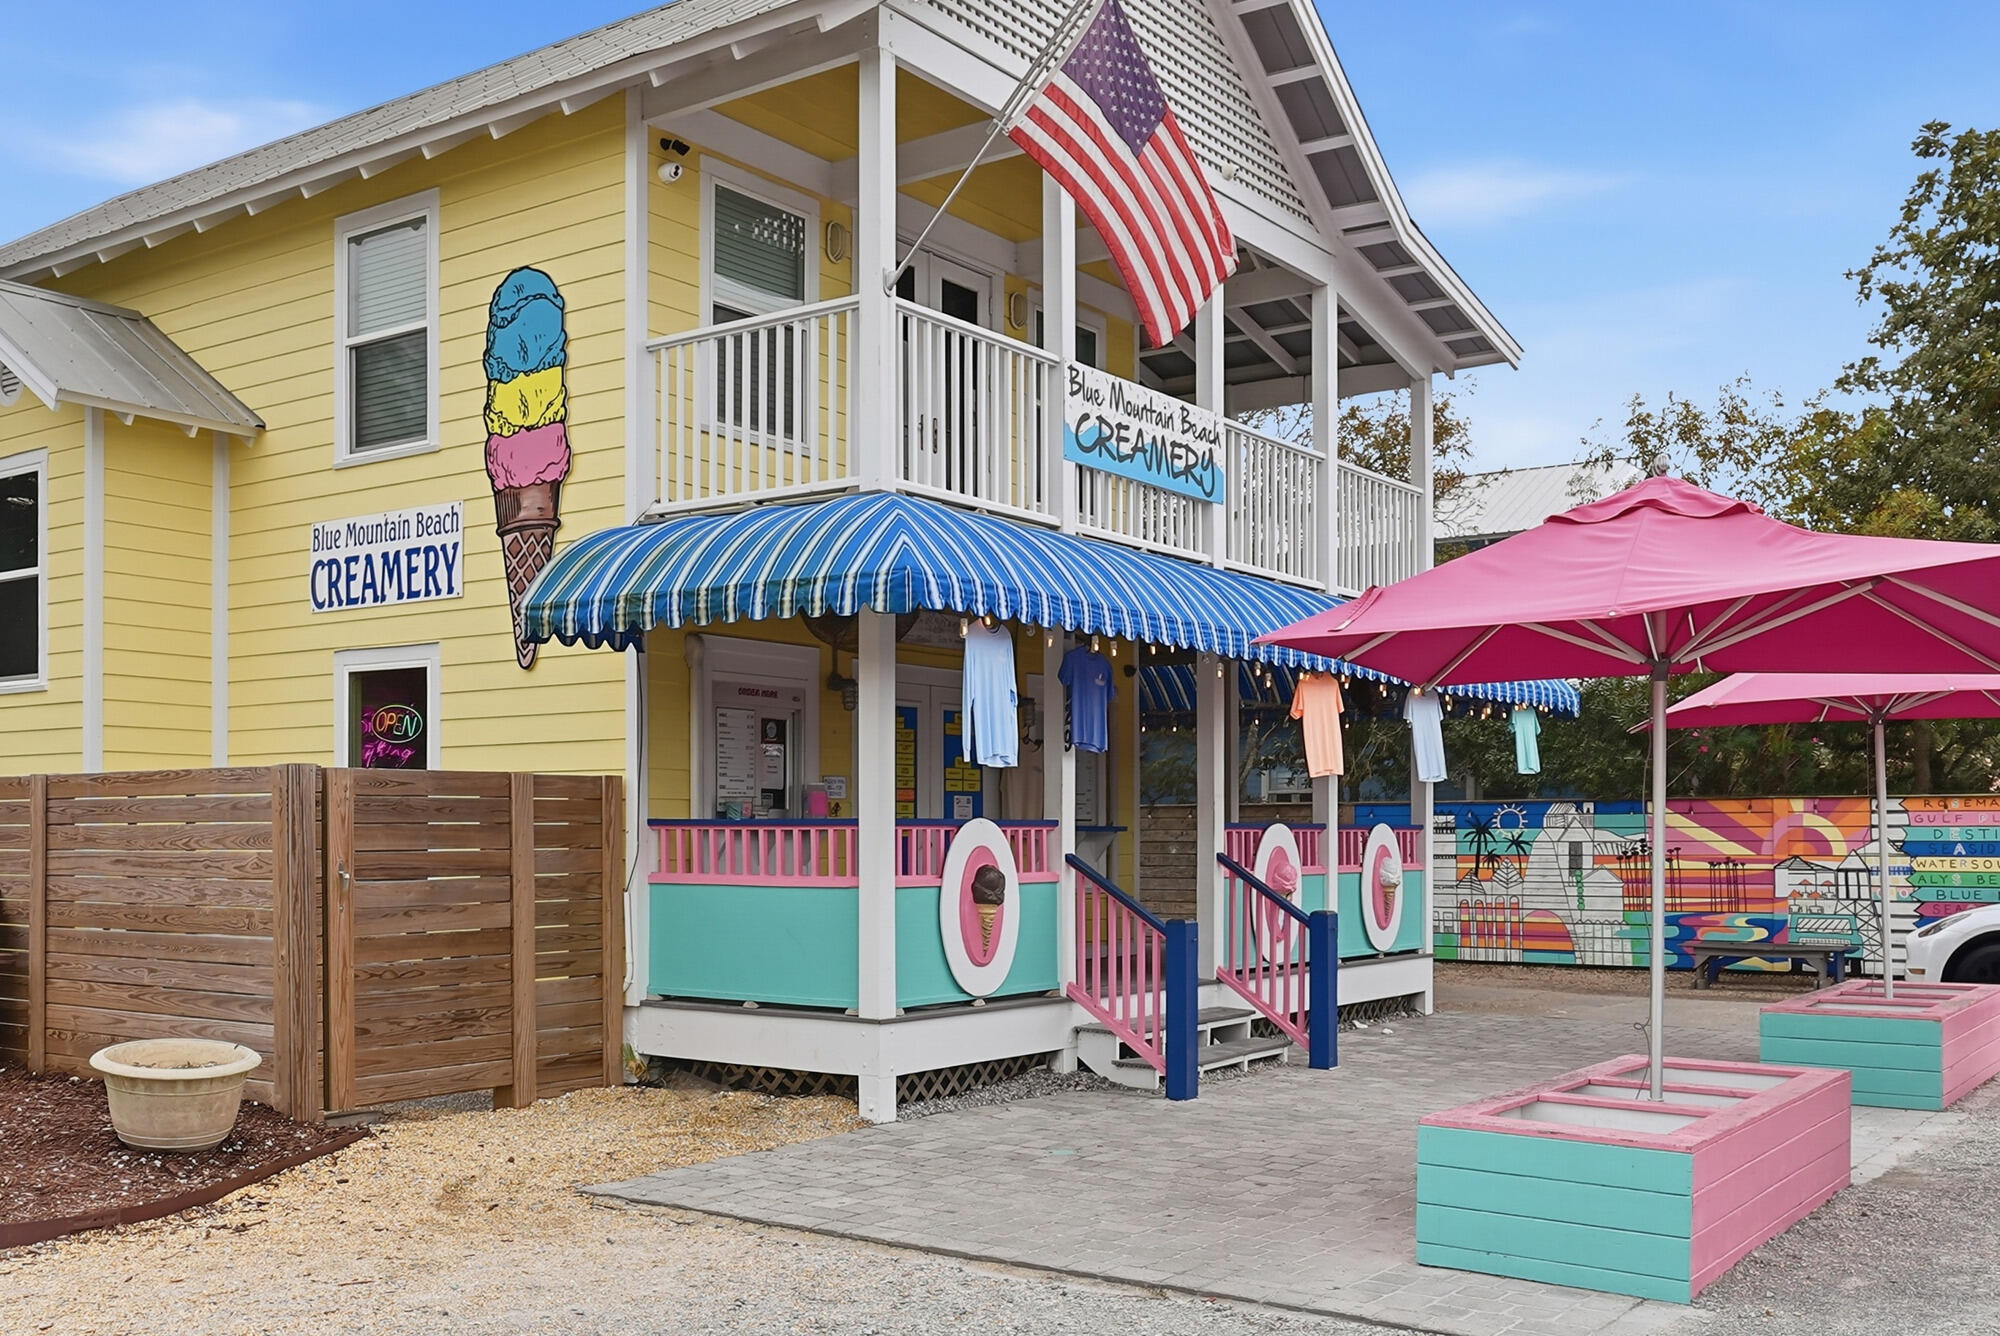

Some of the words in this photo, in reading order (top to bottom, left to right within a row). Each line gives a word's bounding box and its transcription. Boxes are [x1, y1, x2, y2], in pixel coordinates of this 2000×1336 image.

[1067, 364, 1105, 407] Blue
[1110, 381, 1174, 431] Mountain
[1180, 405, 1221, 449] Beach
[1075, 412, 1215, 498] CREAMERY
[312, 525, 341, 552] Blue
[345, 513, 410, 547] Mountain
[416, 505, 459, 538] Beach
[311, 541, 460, 610] CREAMERY
[376, 711, 418, 737] OPEN
[1914, 815, 1963, 823] GULF
[1933, 828, 1998, 840] DESTI
[1928, 842, 1996, 855] SEASID
[1917, 874, 1962, 885] ALYS
[1977, 875, 1998, 885] BE
[1936, 890, 1981, 900] BLUE
